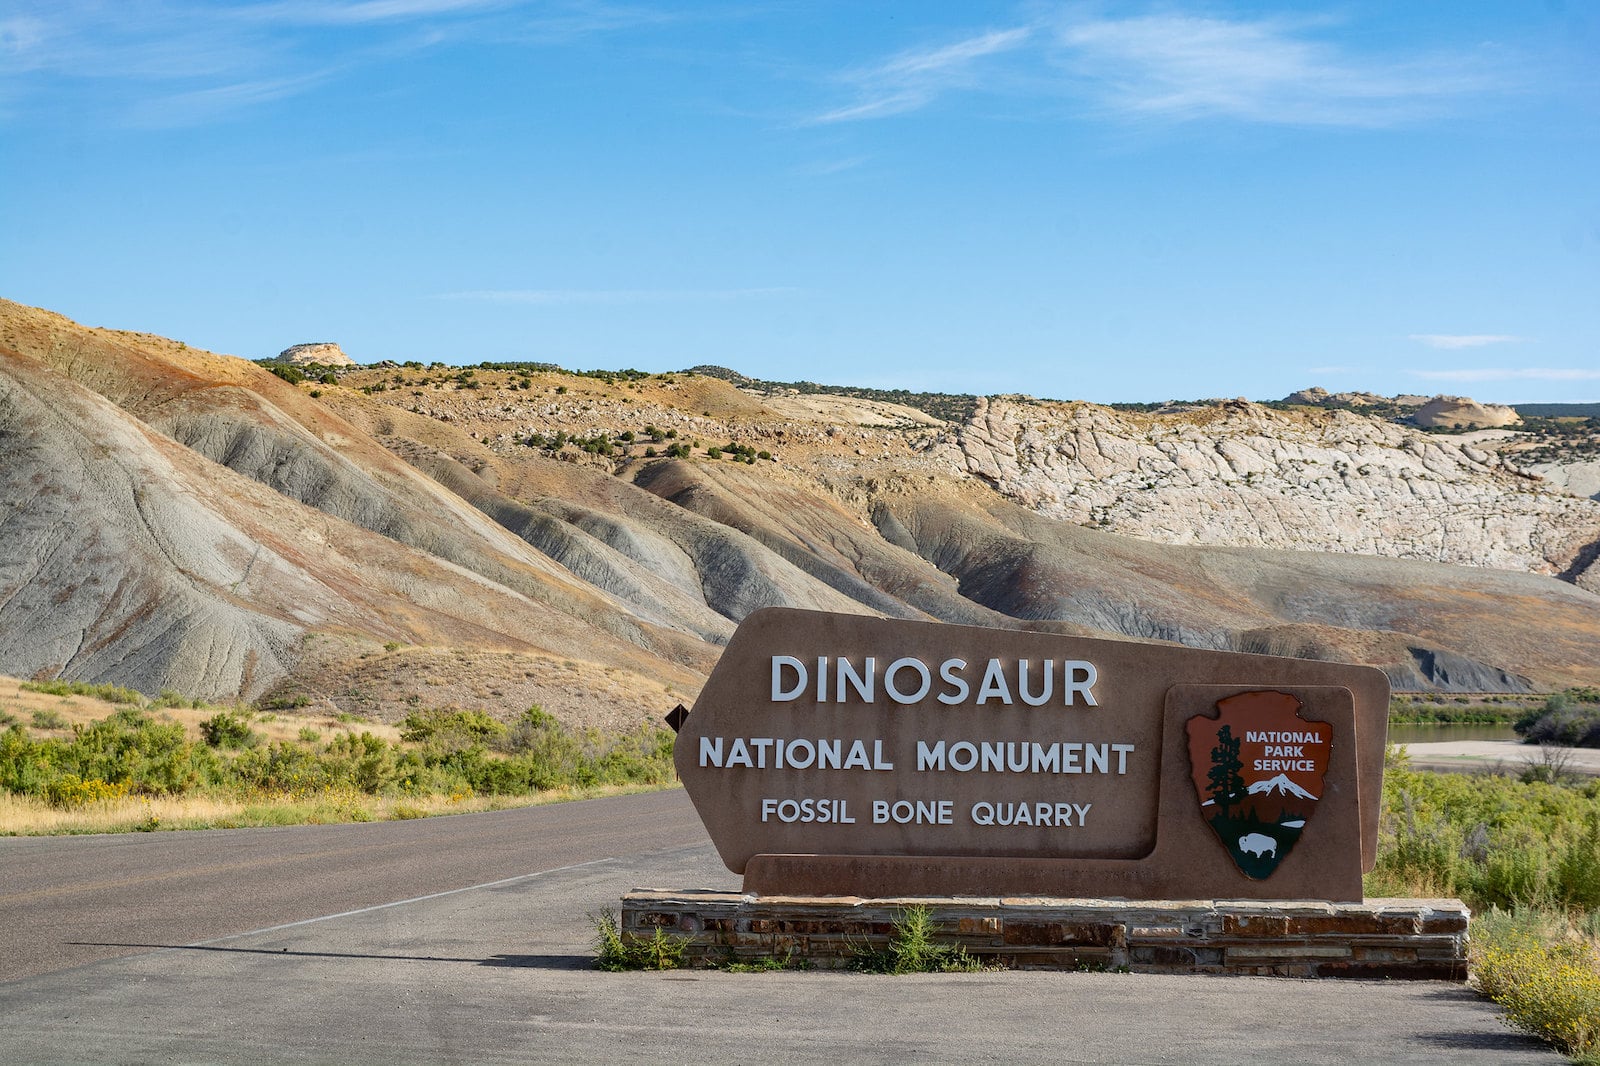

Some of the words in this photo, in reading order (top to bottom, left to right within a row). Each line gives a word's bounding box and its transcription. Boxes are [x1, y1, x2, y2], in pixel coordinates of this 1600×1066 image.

[772, 656, 1098, 706] DINOSAUR
[1247, 732, 1322, 743] NATIONAL
[700, 737, 893, 770] NATIONAL
[918, 741, 1134, 774] MONUMENT
[1265, 746, 1303, 756] PARK
[1254, 760, 1314, 771] SERVICE
[762, 799, 855, 823] FOSSIL
[873, 801, 953, 824] BONE
[972, 802, 1091, 826] QUARRY
